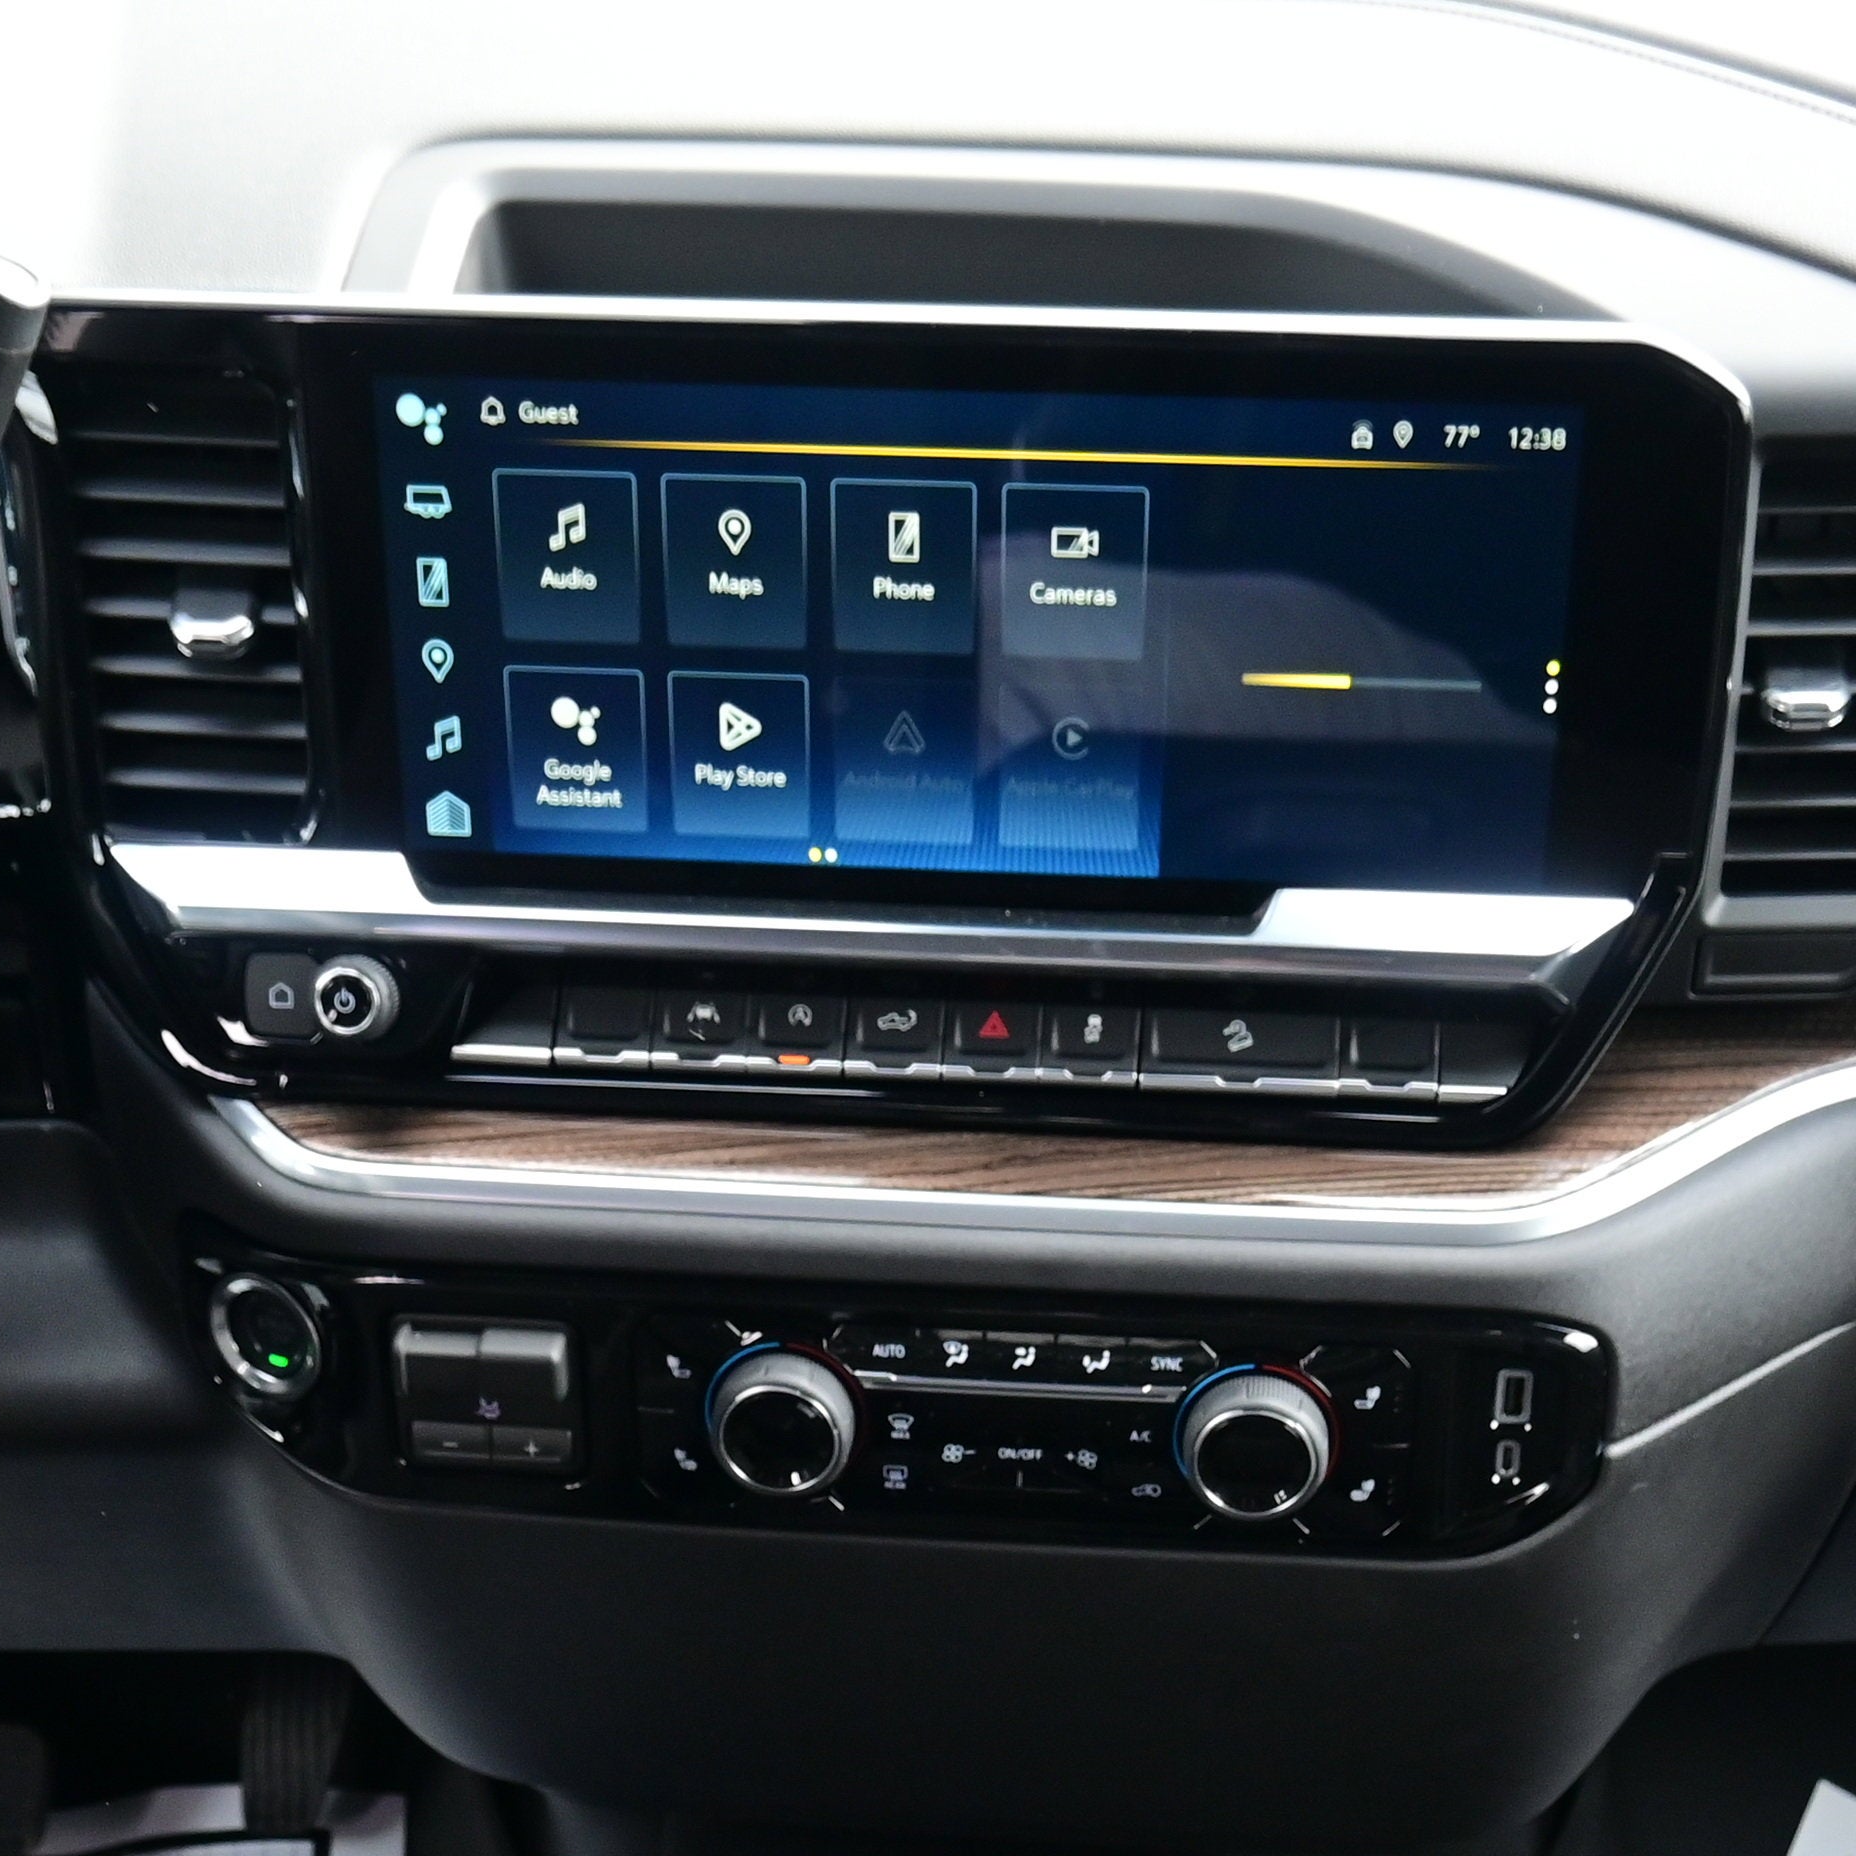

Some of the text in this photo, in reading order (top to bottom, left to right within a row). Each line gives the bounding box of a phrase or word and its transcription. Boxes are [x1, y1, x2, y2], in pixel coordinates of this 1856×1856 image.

[518, 400, 579, 426] Guest
[1508, 427, 1568, 451] 12:38
[540, 566, 598, 592] Audio
[708, 572, 765, 600] Maps
[872, 576, 936, 601] Phone
[1029, 581, 1118, 607] Cameras
[543, 758, 612, 786] Google
[694, 763, 788, 791] Play Store
[536, 784, 623, 808] Assistant
[872, 1343, 906, 1359] AUTO
[1150, 1357, 1183, 1373] SYNC
[997, 1447, 1044, 1461] ON/OFF
